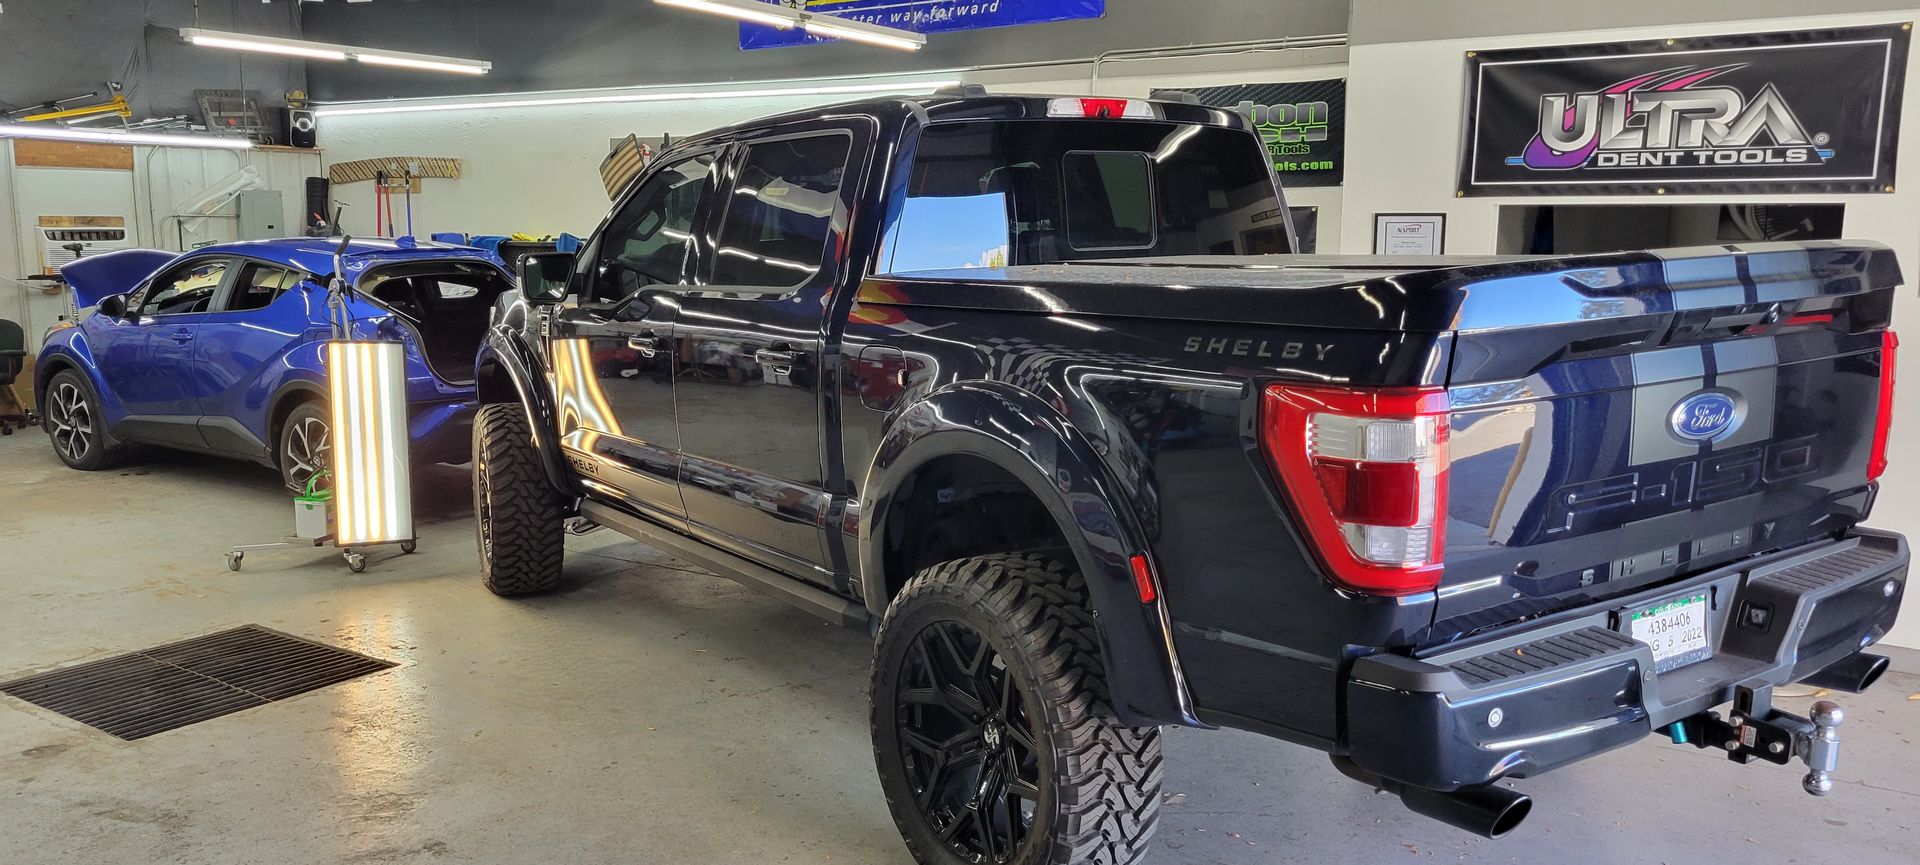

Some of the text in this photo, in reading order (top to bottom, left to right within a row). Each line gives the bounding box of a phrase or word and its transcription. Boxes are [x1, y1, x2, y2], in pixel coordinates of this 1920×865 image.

[851, 0, 1000, 25] tter way forward
[1539, 82, 1812, 152] ULTRA
[1277, 143, 1311, 155] Tools
[1597, 148, 1808, 167] DENT TOOLS
[1274, 161, 1334, 171] ols.com
[1184, 336, 1335, 361] SHELBY
[1691, 402, 1726, 430] Ford
[567, 455, 599, 475] SHELBY
[1547, 433, 1820, 535] F-150
[1580, 521, 1776, 588] SHELBY
[1648, 611, 1691, 636] 4384406
[1667, 635, 1674, 648] 5
[1681, 626, 1702, 643] 2022
